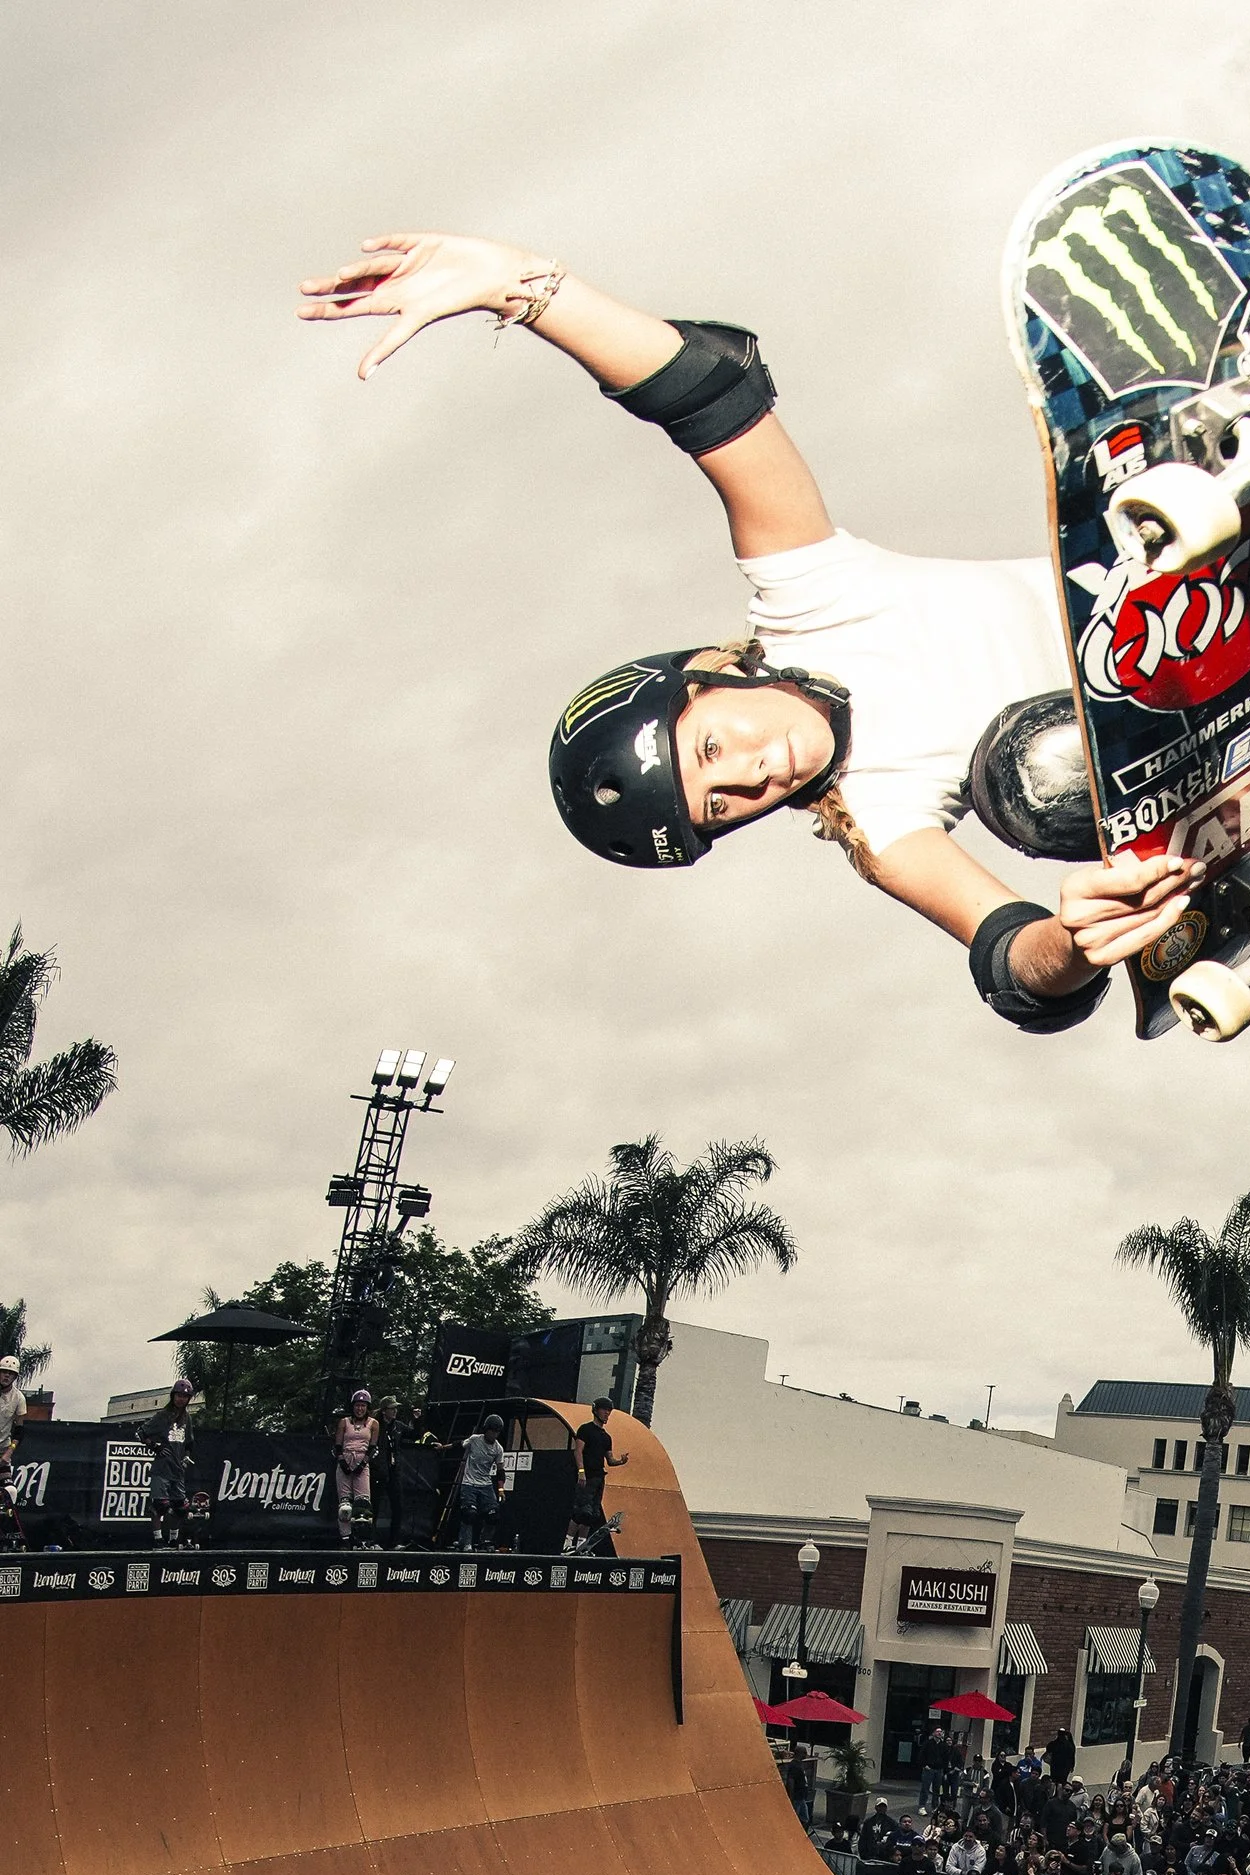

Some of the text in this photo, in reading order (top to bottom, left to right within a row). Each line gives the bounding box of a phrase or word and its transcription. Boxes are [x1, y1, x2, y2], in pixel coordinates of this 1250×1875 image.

[652, 826, 674, 862] STER
[1160, 924, 1185, 943] BRO
[473, 1362, 505, 1377] SPORTS
[112, 1446, 156, 1456] JACKALO
[109, 1461, 151, 1486] BLOC
[105, 1491, 150, 1517] PART
[271, 1502, 307, 1512] california
[128, 1570, 148, 1579] BLOCK
[127, 1580, 148, 1590] PARTY
[908, 1579, 988, 1602] MAKI SUSHI
[911, 1601, 984, 1613] JAPANESE RESTAURANT
